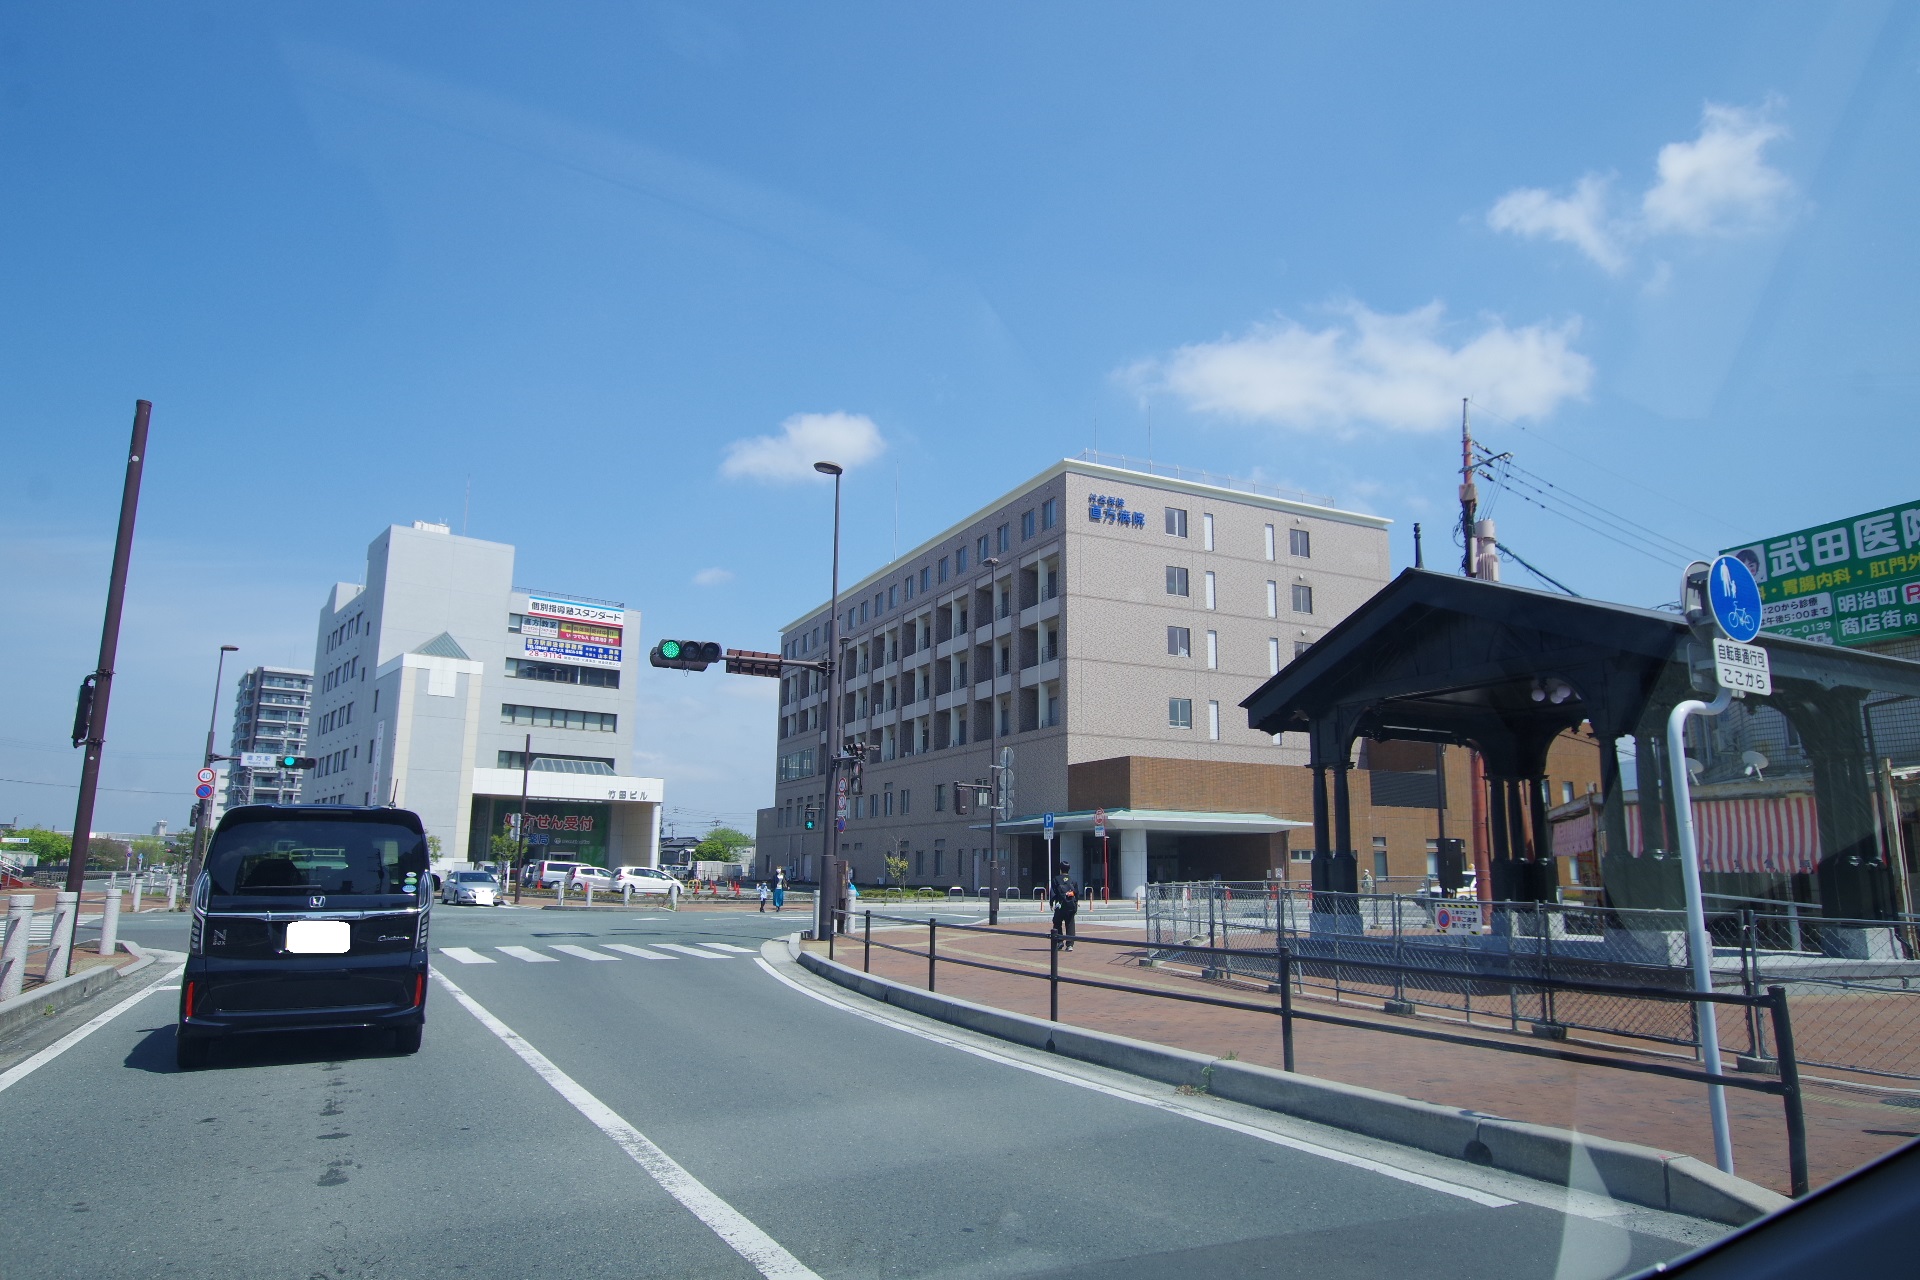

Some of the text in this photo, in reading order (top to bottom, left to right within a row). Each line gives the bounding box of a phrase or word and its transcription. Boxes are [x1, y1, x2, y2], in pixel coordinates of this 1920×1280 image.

[1090, 504, 1145, 527] 直方病院
[1838, 586, 1898, 613] 明治町
[531, 601, 621, 621] 個別指導塾スタンダード
[1840, 610, 1902, 637] 商店街
[528, 650, 562, 659] 28-9114
[1718, 644, 1766, 668] 自転車通行可
[1724, 668, 1765, 689] ここから
[201, 772, 211, 780] 40
[608, 790, 648, 801] 竹田ビル
